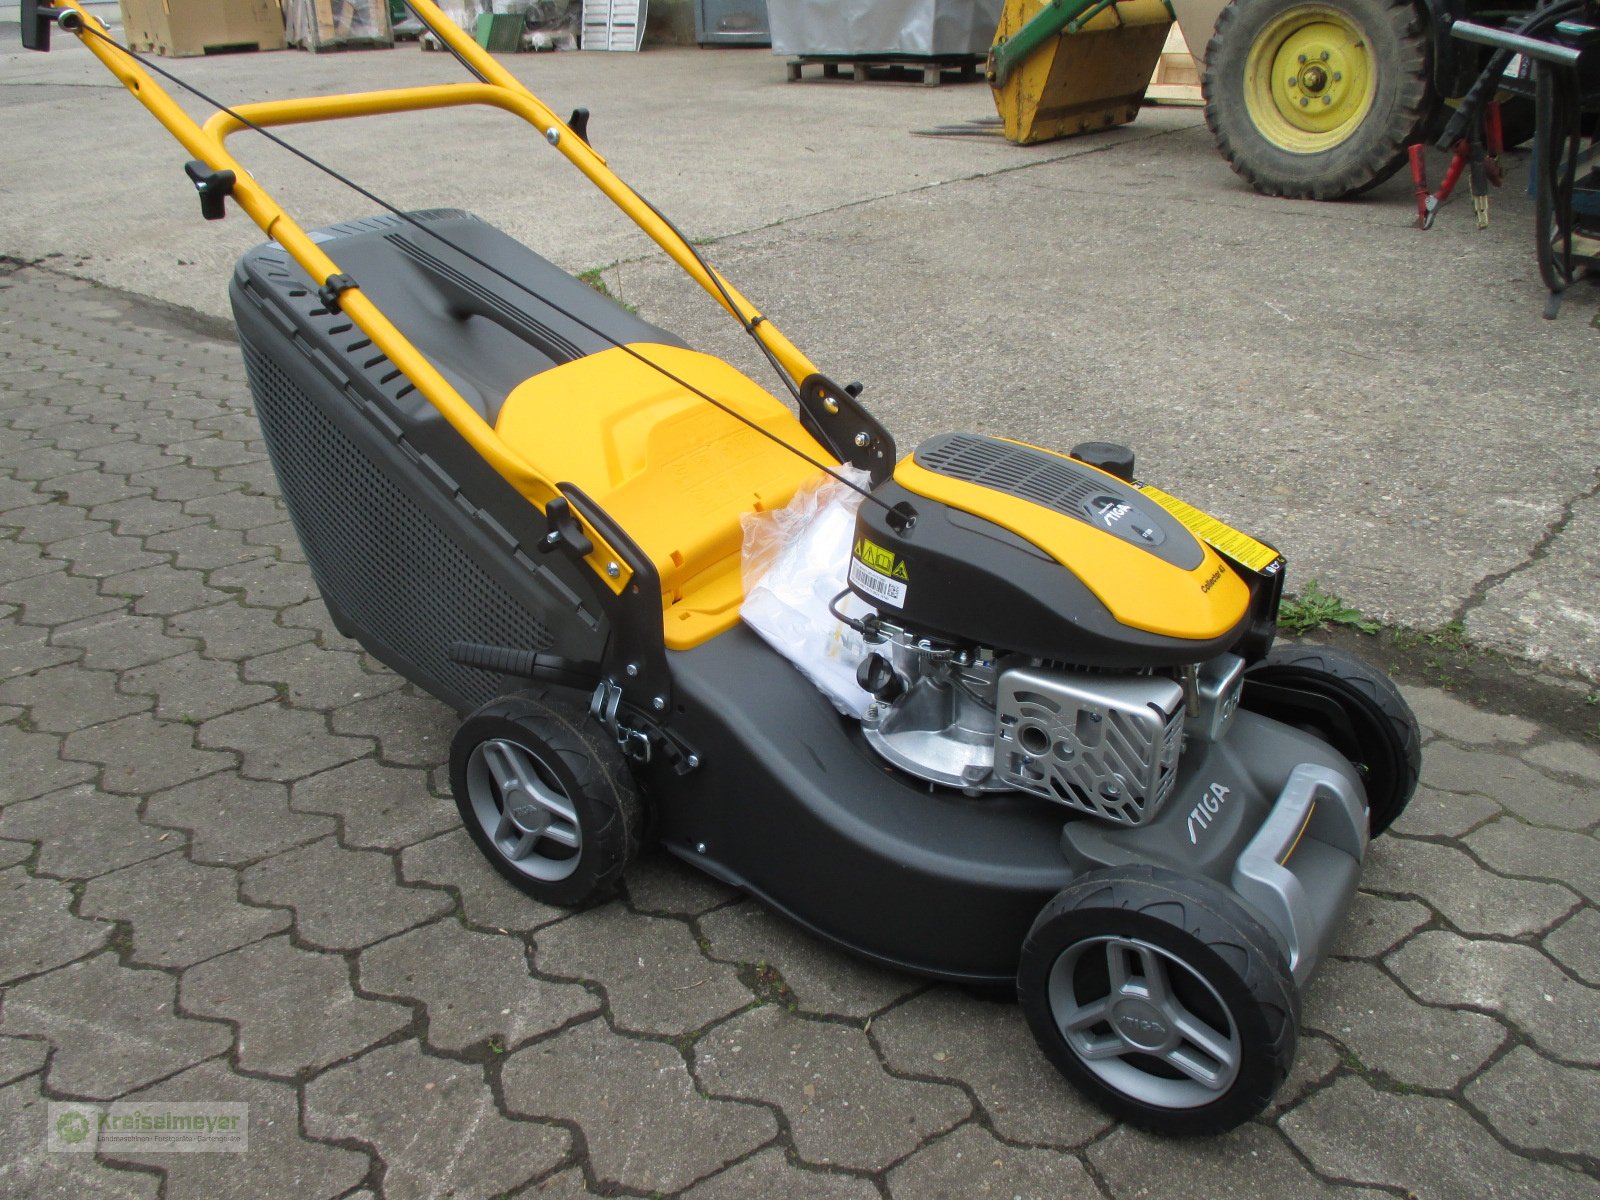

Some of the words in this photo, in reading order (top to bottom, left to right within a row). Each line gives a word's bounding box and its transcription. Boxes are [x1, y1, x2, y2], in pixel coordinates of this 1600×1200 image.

[1103, 504, 1132, 527] STIGA
[1200, 571, 1221, 594] Collector
[1187, 782, 1230, 845] STIGA
